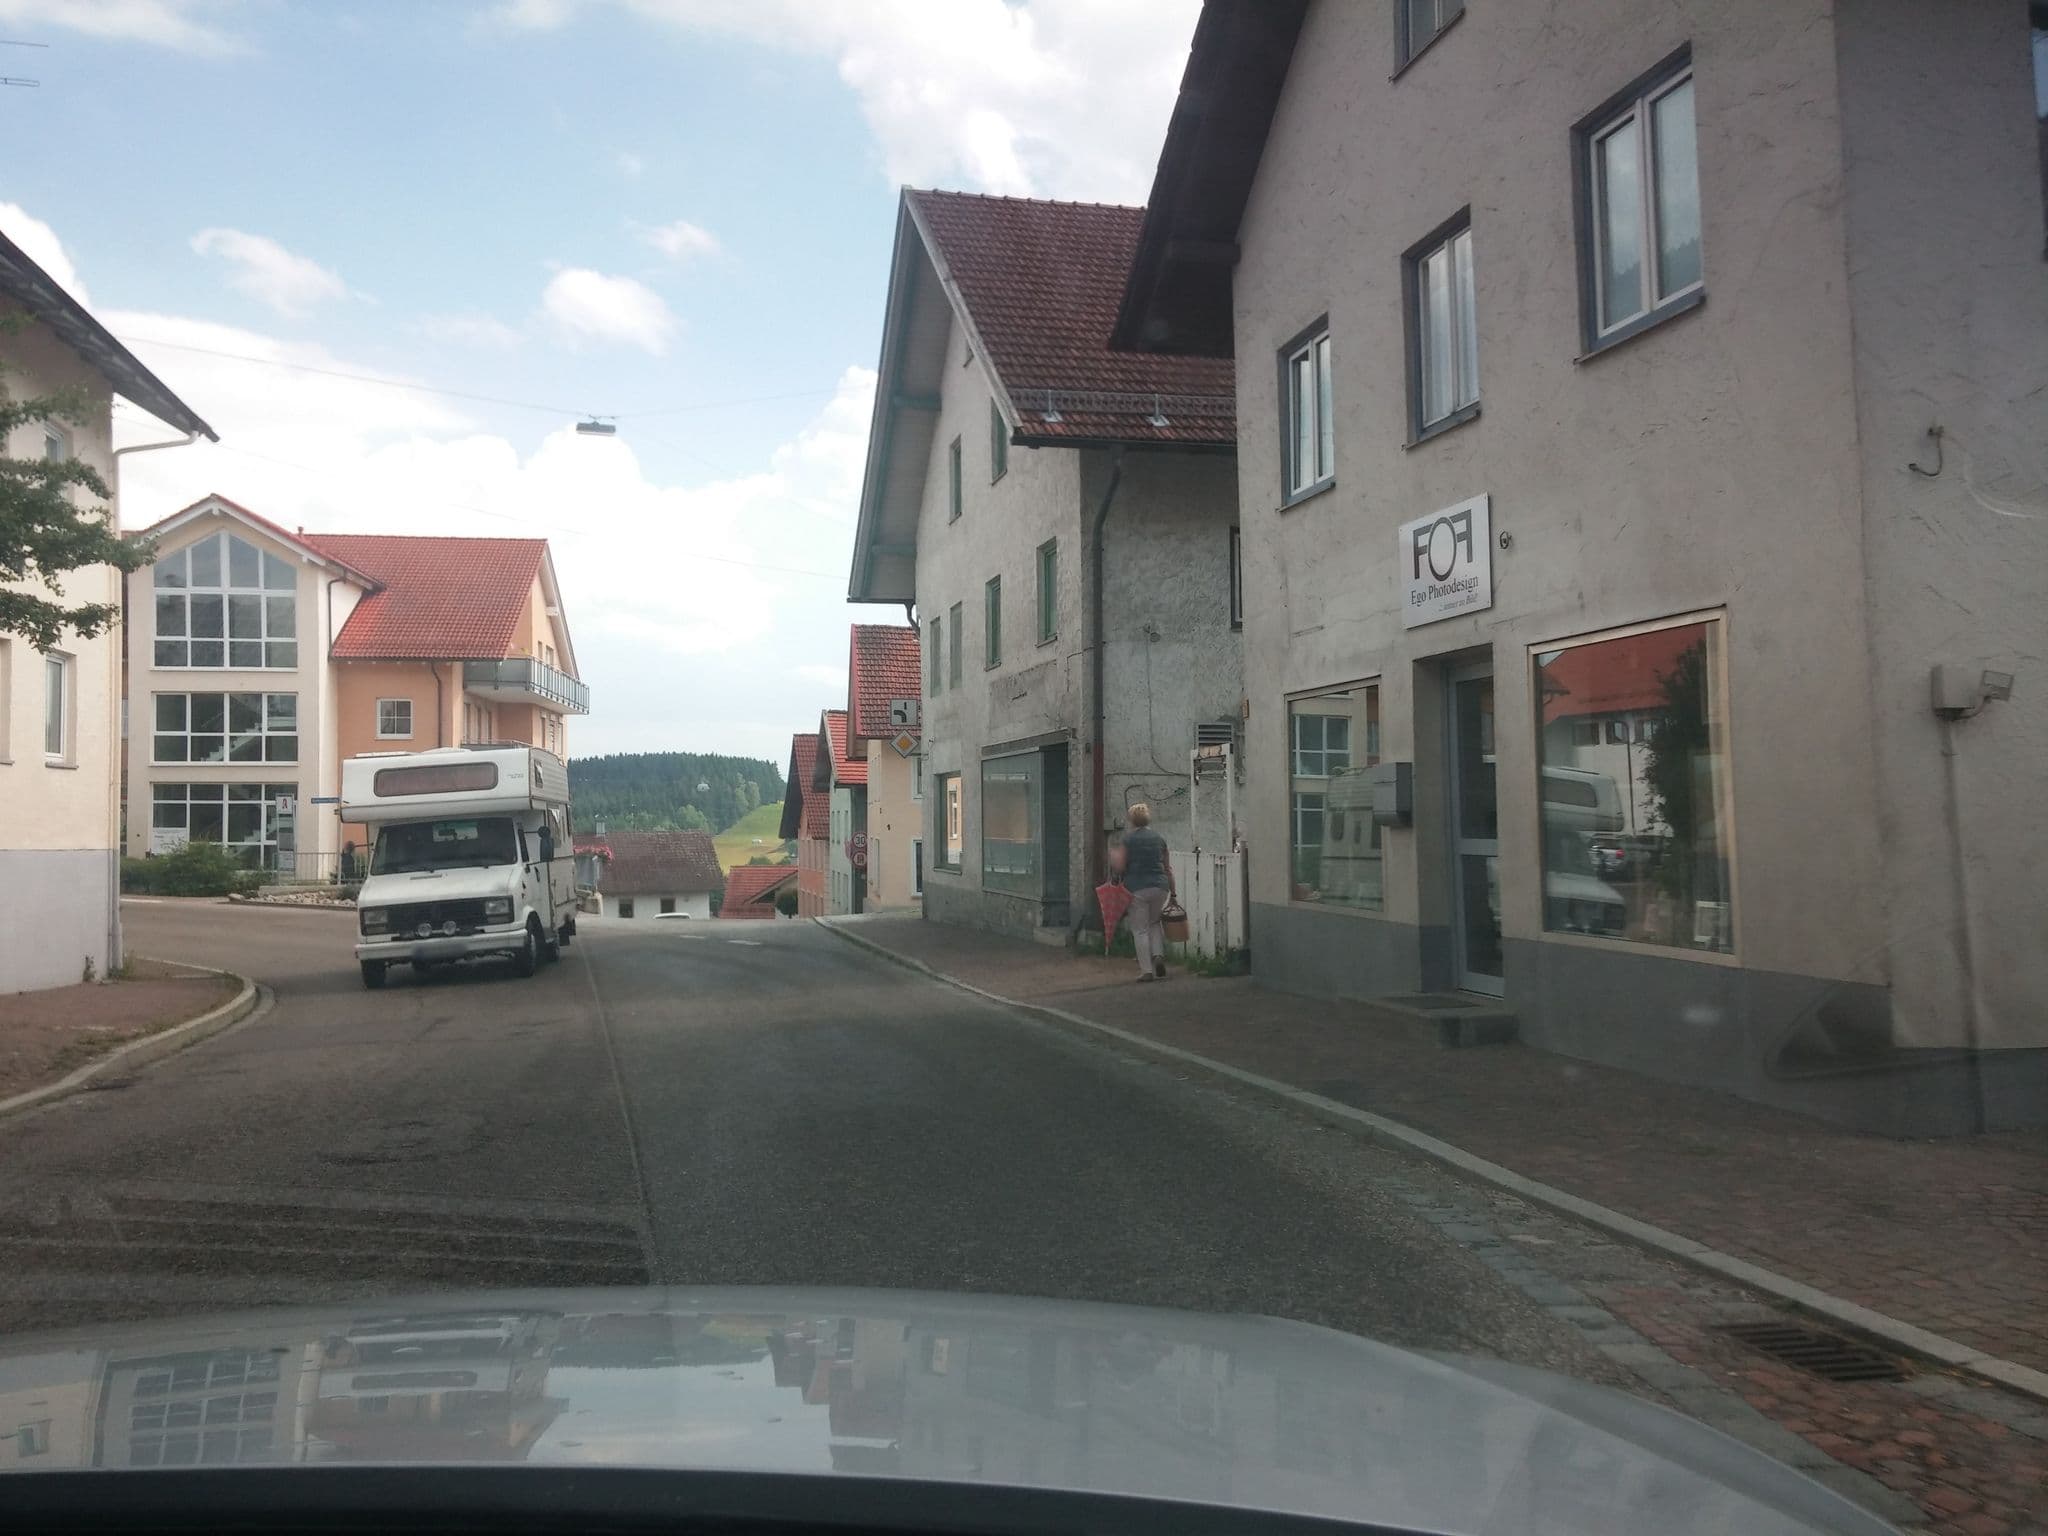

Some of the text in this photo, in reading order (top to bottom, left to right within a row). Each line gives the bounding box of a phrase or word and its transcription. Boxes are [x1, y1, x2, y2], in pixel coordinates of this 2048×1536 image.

[1411, 590, 1427, 607] Ego
[1428, 575, 1479, 601] Photodesign
[855, 836, 866, 845] 30
